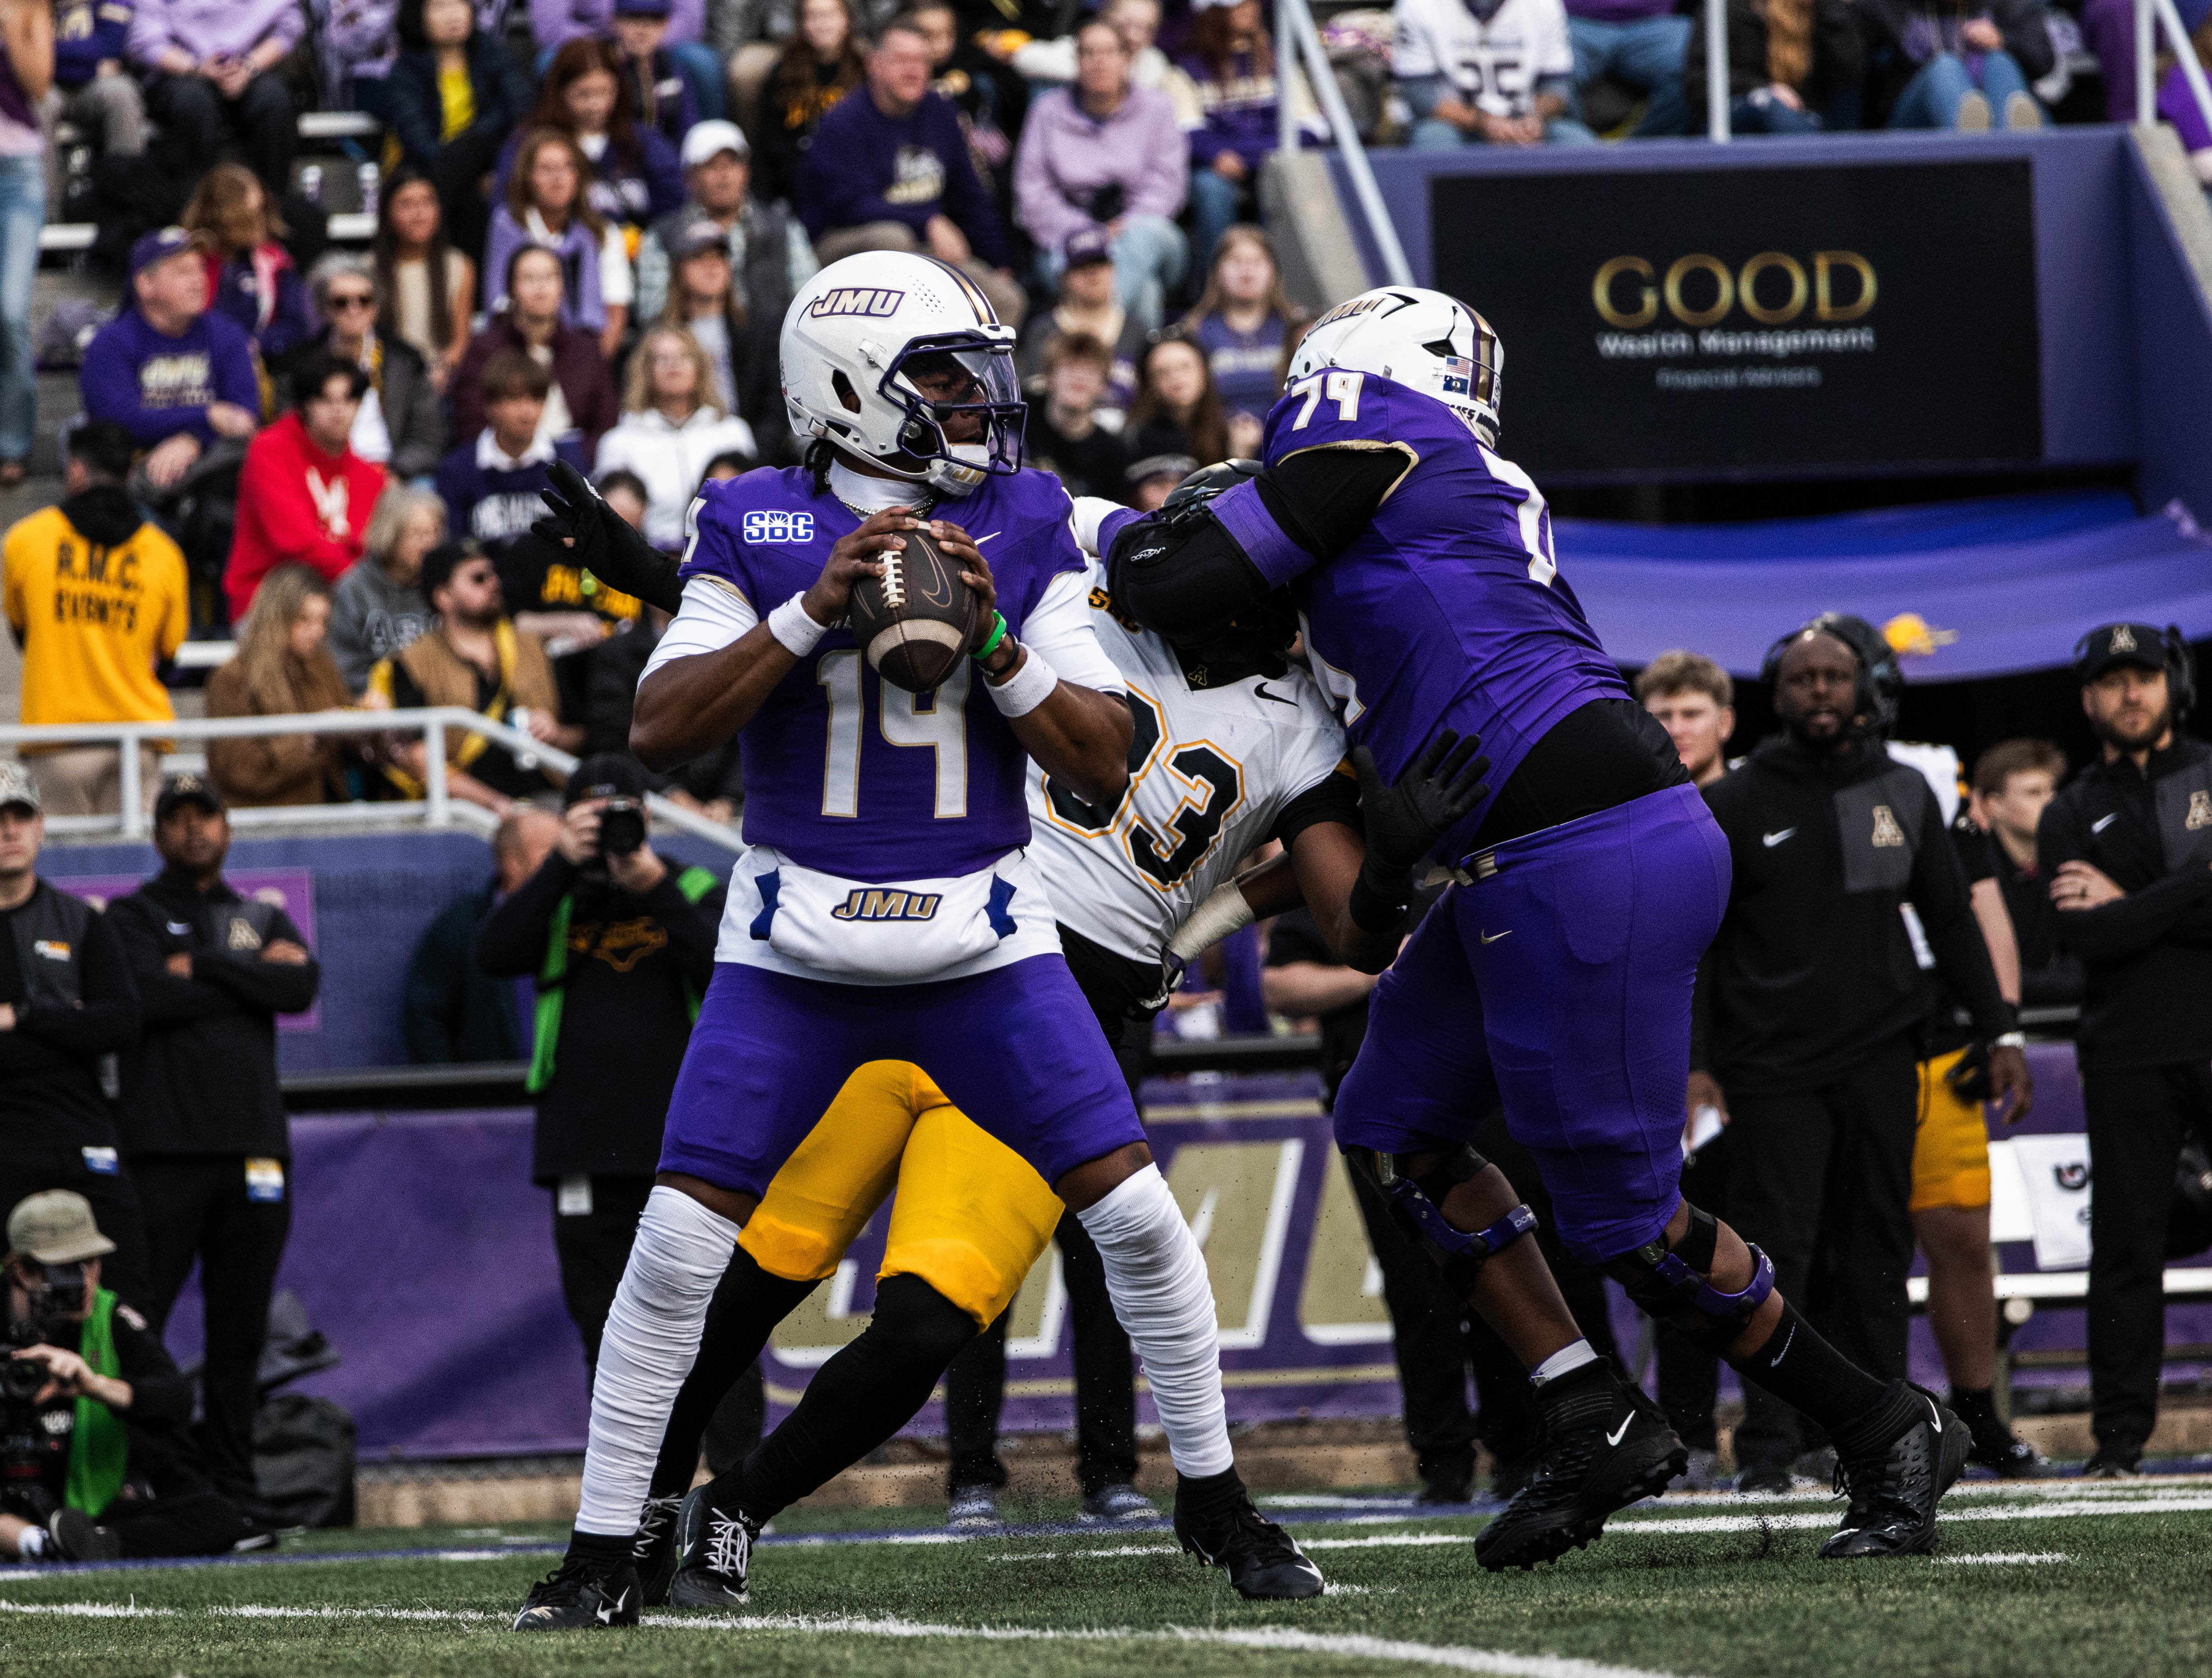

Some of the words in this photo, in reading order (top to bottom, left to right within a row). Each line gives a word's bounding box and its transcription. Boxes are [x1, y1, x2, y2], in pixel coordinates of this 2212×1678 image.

[812, 288, 905, 318] JMU
[1591, 250, 1878, 329] GOOD
[1595, 330, 1694, 359] Wealth
[1698, 326, 1876, 358] Management
[1291, 371, 1365, 432] 79
[743, 509, 814, 544] SBC
[817, 650, 971, 819] 14
[831, 887, 944, 922] JMU
